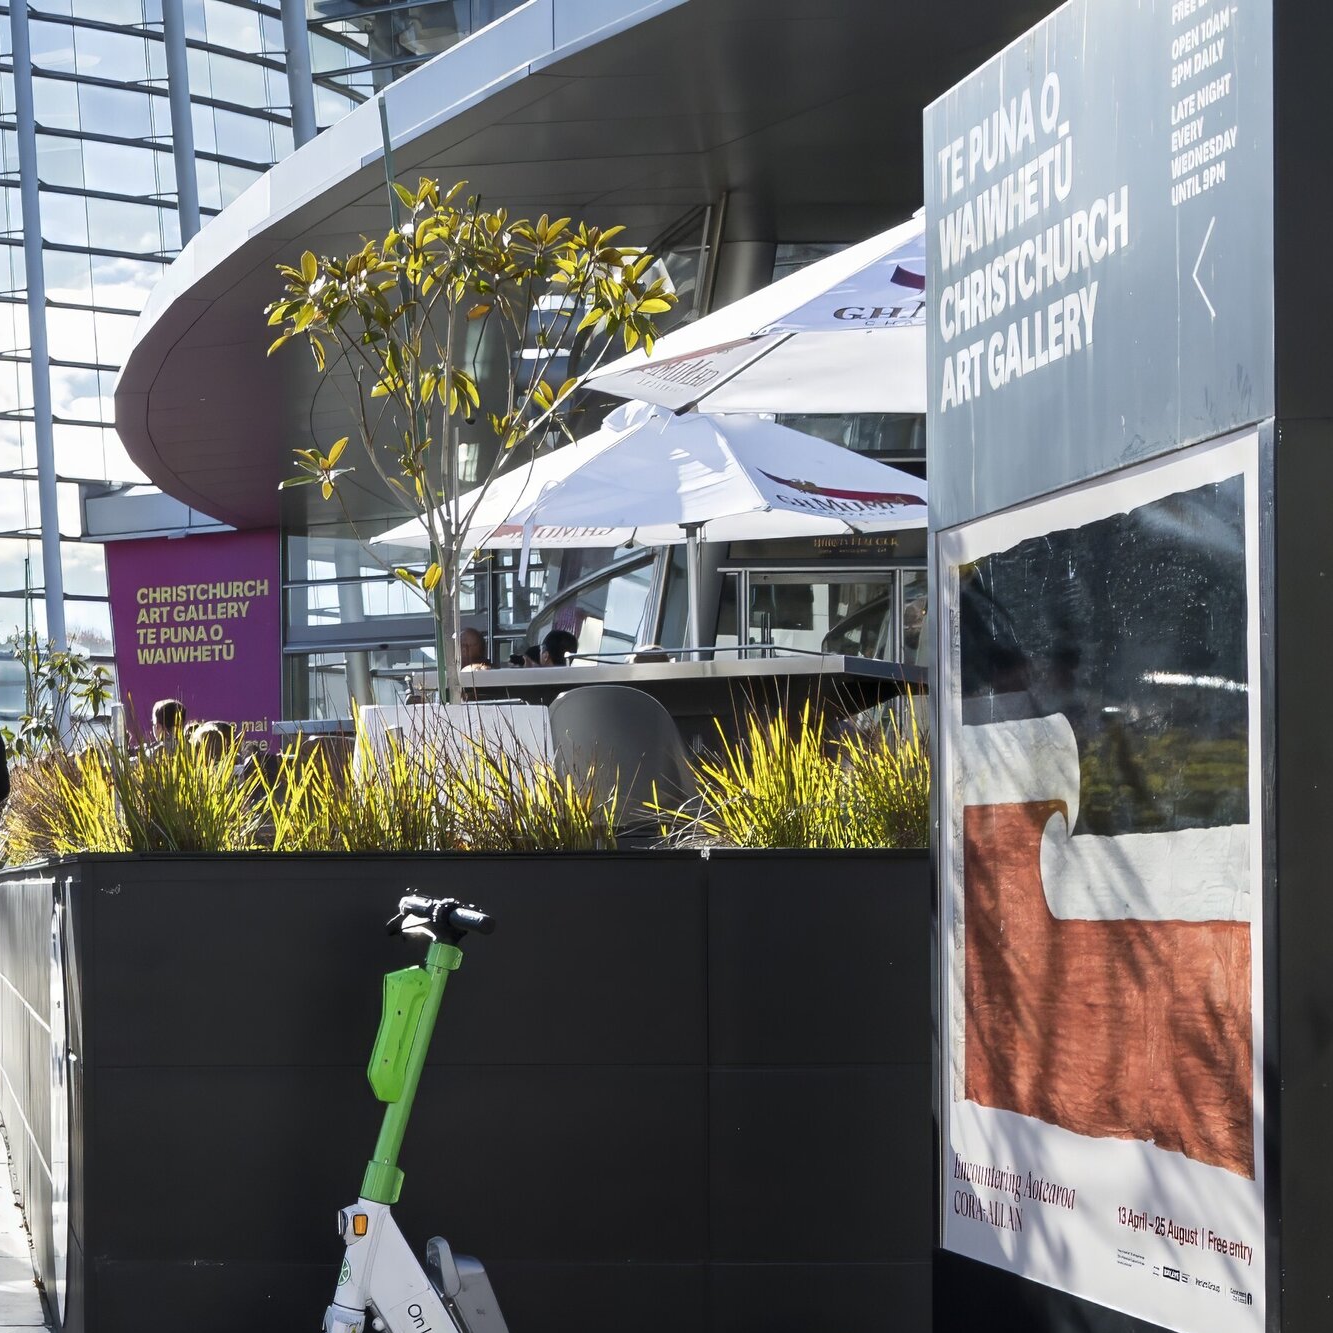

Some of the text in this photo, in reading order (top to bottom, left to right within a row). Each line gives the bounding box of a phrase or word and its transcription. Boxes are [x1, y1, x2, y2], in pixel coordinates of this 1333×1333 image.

[1172, 26, 1199, 60] OPEN
[1201, 6, 1229, 42] 10AM
[1171, 38, 1224, 88] 5PM DAILY
[1171, 73, 1231, 125] LATE NIGHT
[938, 71, 1061, 203] TE PUNA O
[1171, 126, 1237, 180] WEDNESDAY
[1172, 116, 1204, 152] EVERY
[939, 120, 1073, 272] WAIWHETŪ
[1172, 160, 1225, 206] UNTIL 9PM
[939, 185, 1129, 343] CHRISTCHURCH
[940, 281, 1098, 413] ART GALLERY
[136, 579, 269, 605] CHRISTCHURCH
[136, 601, 249, 624] ART GALLERY
[137, 624, 223, 645] TE PUNA O
[137, 640, 234, 665] WAIWHETŪ
[241, 717, 267, 732] mai
[954, 1153, 1075, 1210] Encountering Aotearoa
[954, 1190, 1023, 1232] CORA-ALLAN
[1118, 1206, 1127, 1225] 13
[1127, 1209, 1148, 1232] April
[1155, 1216, 1166, 1237] 25
[1167, 1220, 1198, 1246] August
[1208, 1230, 1228, 1254] Free
[1229, 1240, 1253, 1266] entry
[407, 1304, 425, 1329] On
